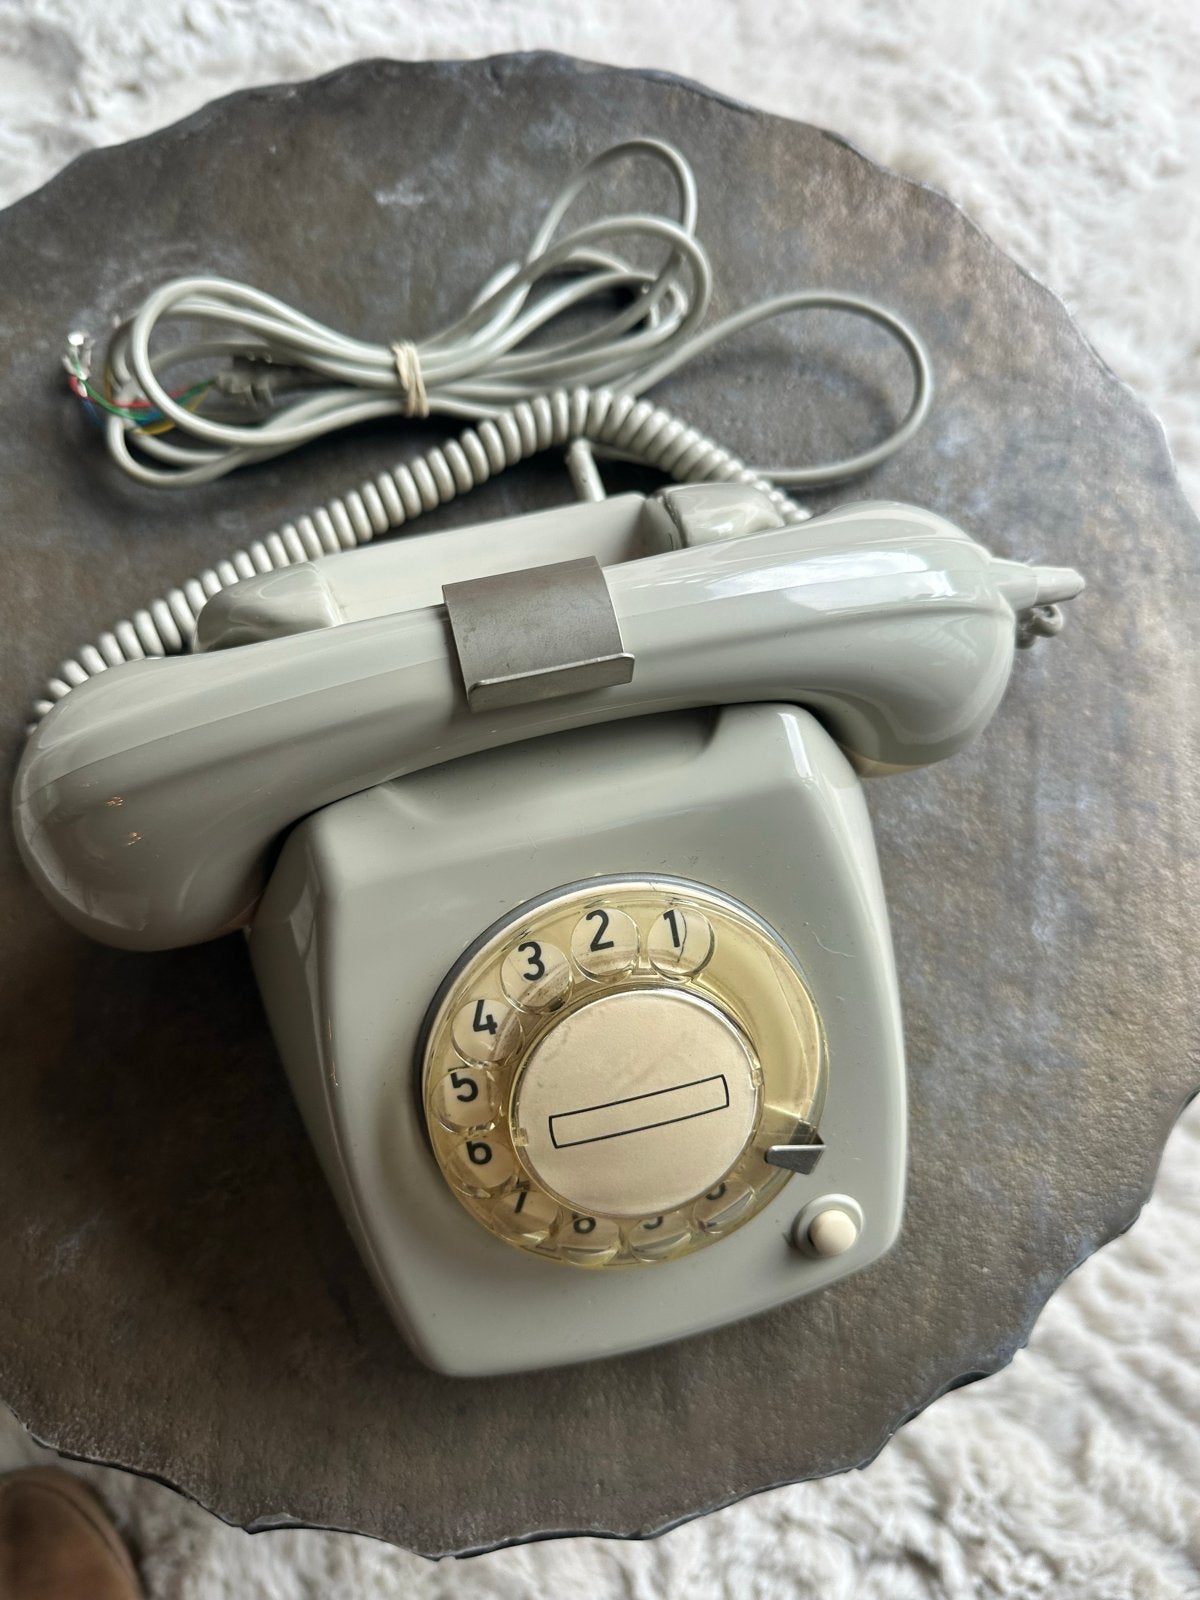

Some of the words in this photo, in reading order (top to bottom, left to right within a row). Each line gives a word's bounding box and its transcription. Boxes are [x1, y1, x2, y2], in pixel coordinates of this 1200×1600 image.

[586, 909, 614, 952] 2
[663, 909, 681, 948] 1
[518, 941, 546, 981] 3
[472, 999, 498, 1035] 4
[449, 1069, 479, 1102] 5
[466, 1141, 492, 1165] 6
